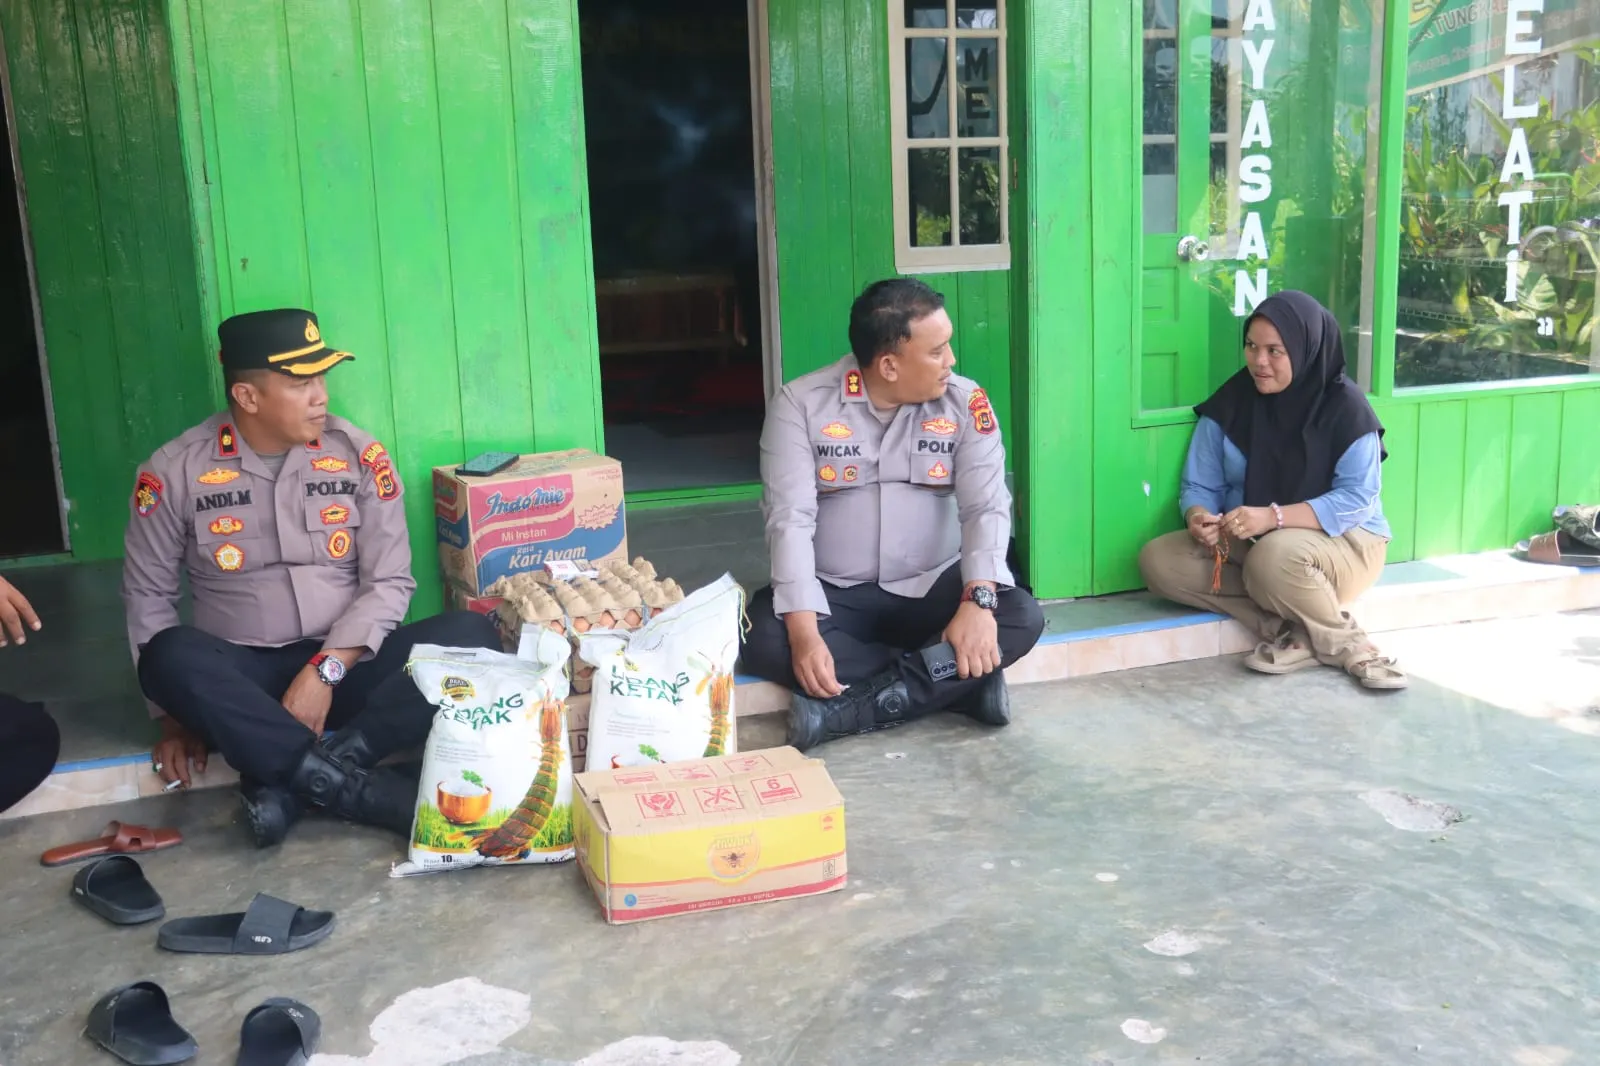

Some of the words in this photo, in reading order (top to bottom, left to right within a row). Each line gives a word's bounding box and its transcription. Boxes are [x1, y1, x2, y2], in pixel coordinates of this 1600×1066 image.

[817, 445, 861, 458] WICAK
[917, 439, 955, 454] POL
[305, 480, 358, 497] POLRI
[196, 489, 252, 512] ANDI.M
[501, 531, 514, 542] Mi
[516, 528, 547, 541] Instan
[508, 549, 543, 569] Kari
[767, 778, 780, 790] 6
[441, 854, 453, 863] 10
